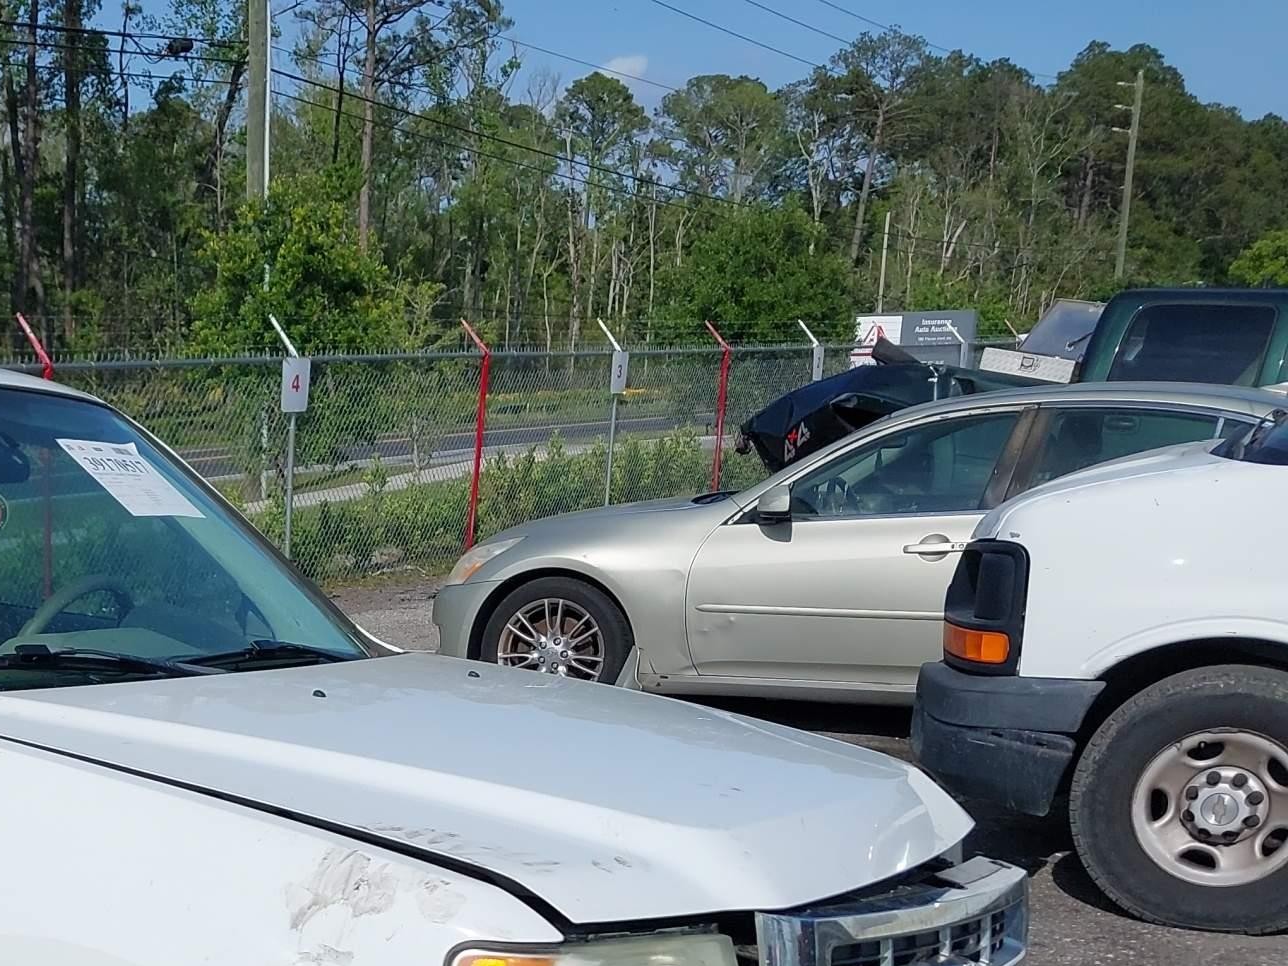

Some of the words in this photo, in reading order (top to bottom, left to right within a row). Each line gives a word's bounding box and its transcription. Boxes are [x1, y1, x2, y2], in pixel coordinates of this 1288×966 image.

[617, 364, 623, 379] 3
[291, 374, 300, 393] 4
[83, 456, 150, 474] 39170517
